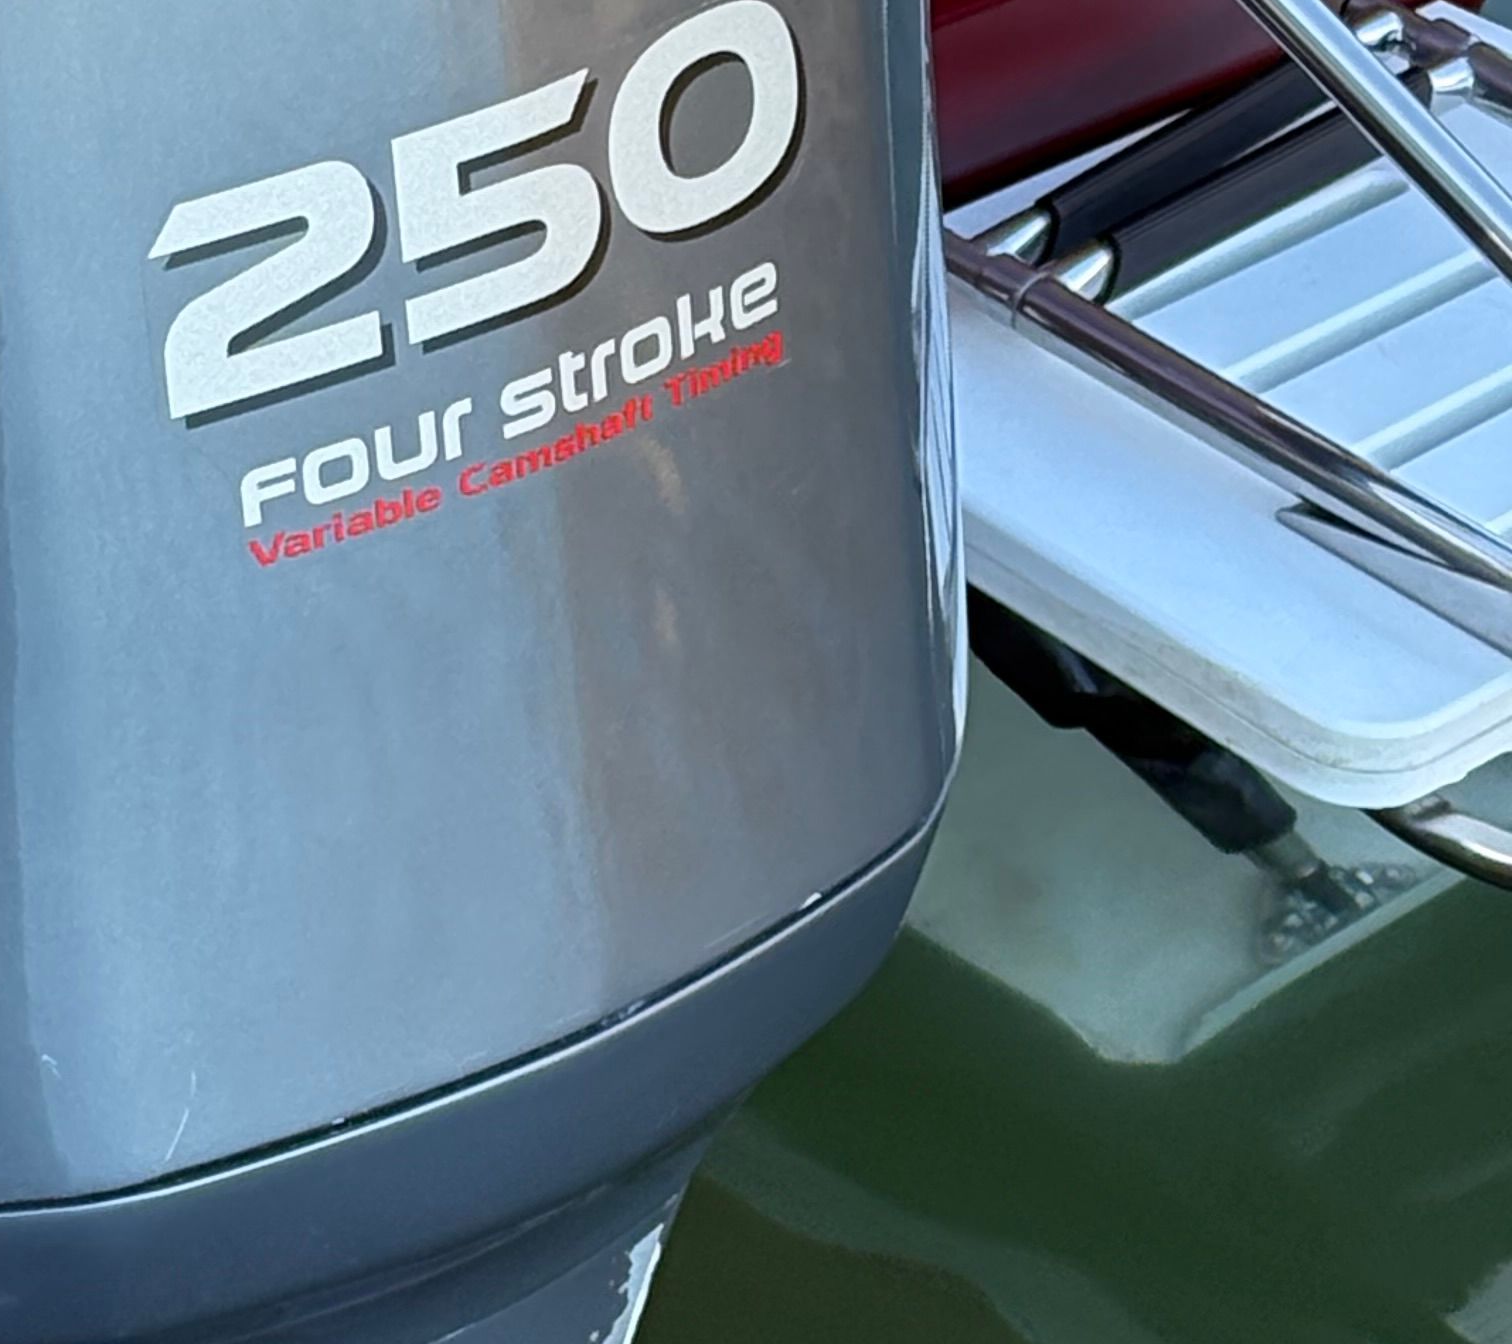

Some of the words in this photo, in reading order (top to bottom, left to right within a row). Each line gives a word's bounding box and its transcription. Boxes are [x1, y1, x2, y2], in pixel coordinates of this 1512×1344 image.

[248, 486, 443, 568] Variable
[459, 394, 654, 497] Camshaft
[664, 330, 785, 407] Timing
[500, 261, 778, 440] stroke
